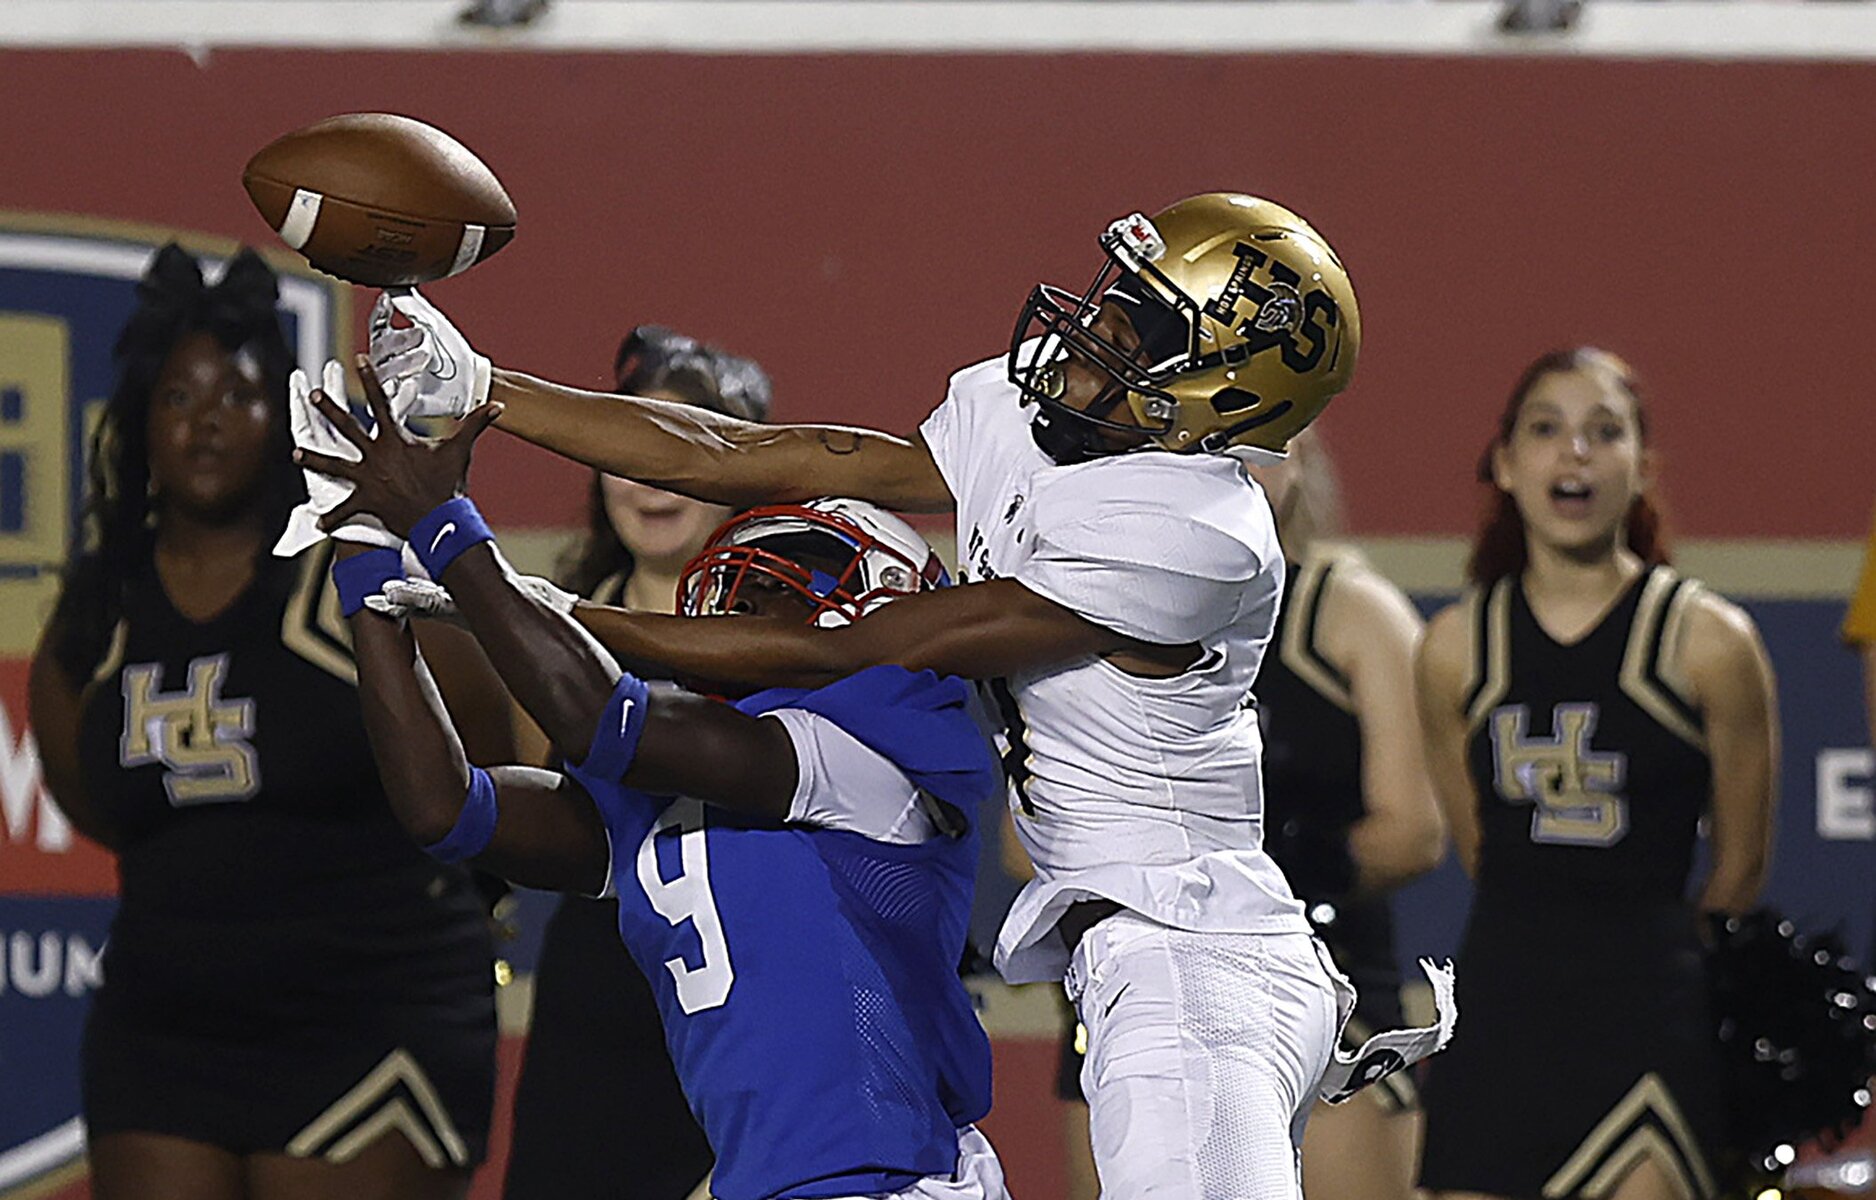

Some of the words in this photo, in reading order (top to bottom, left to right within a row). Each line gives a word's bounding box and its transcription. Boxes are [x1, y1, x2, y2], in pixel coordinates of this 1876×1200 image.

[119, 653, 262, 808] HS
[1489, 701, 1630, 848] HS
[637, 797, 734, 1015] 9
